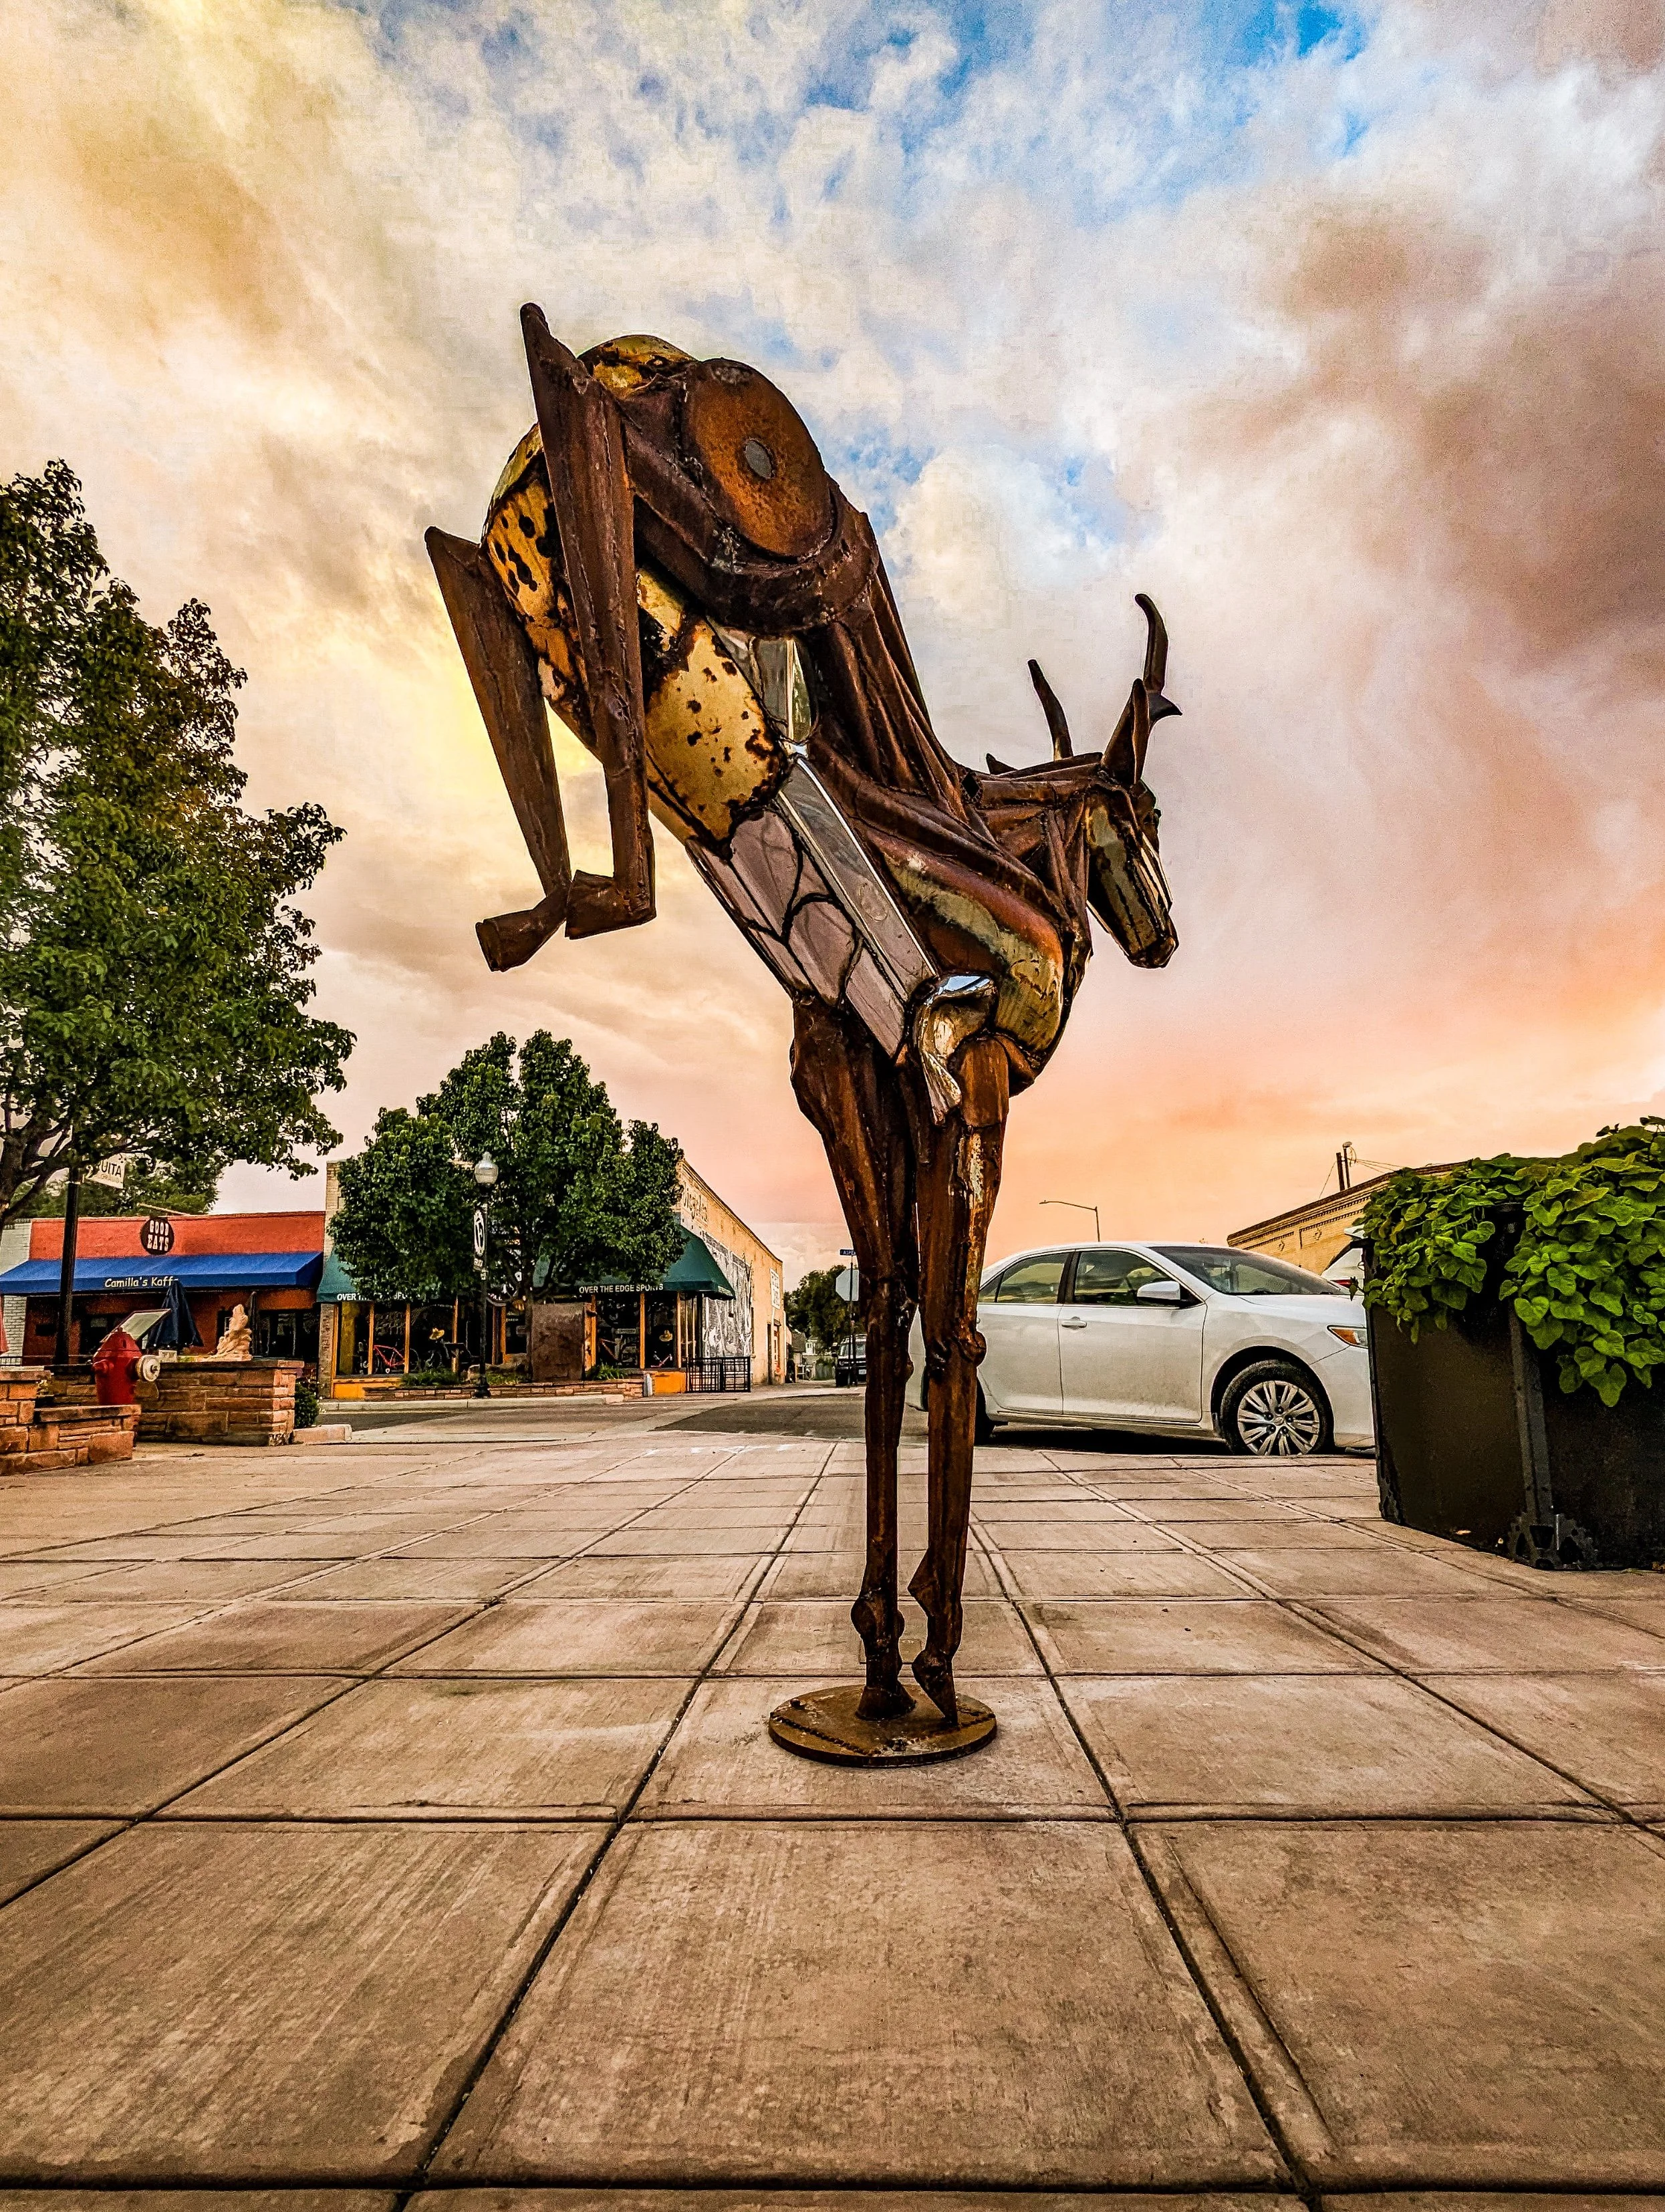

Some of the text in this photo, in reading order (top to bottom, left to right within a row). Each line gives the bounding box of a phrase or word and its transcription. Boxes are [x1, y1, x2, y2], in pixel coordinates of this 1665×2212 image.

[100, 1159, 122, 1178] UITA
[149, 1220, 169, 1236] GOOD
[147, 1234, 169, 1252] EATS
[104, 1276, 178, 1288] Camilla's Kaff
[579, 1286, 598, 1294] OVER
[600, 1285, 614, 1293] THE
[615, 1284, 634, 1292] EDGE
[337, 1292, 356, 1301] OVER
